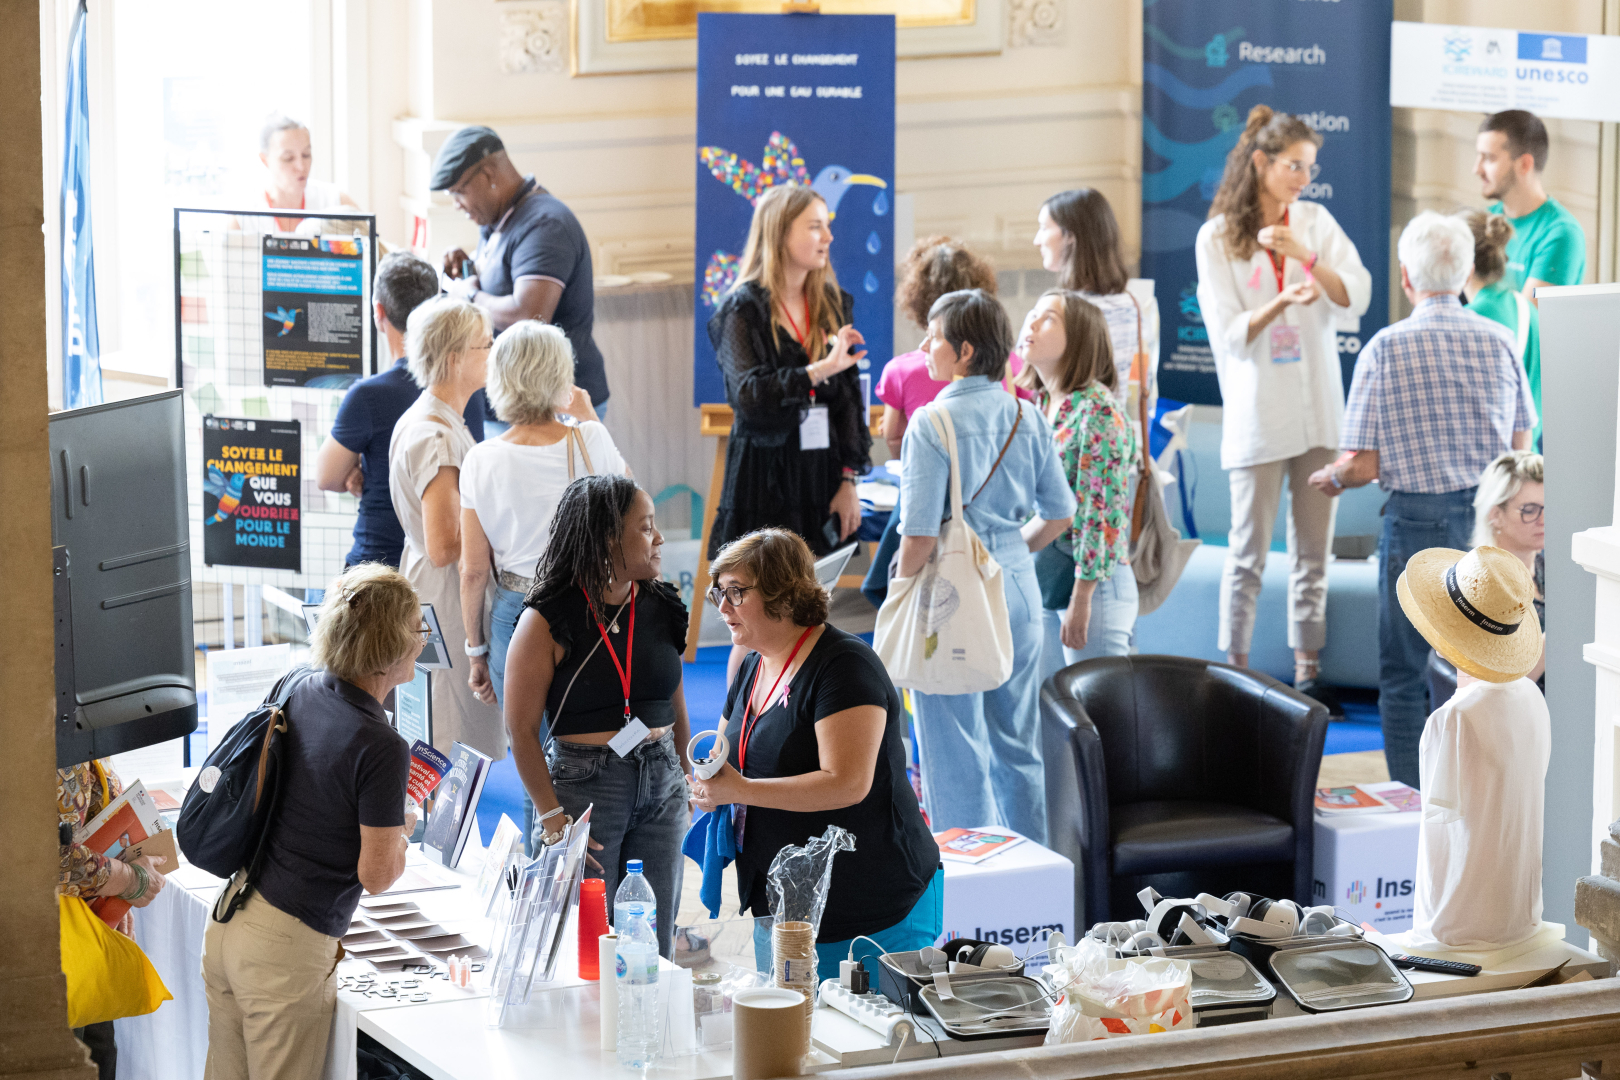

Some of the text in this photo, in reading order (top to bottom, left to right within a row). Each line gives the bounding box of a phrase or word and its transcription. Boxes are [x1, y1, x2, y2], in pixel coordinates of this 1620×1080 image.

[774, 53, 788, 66] LE
[1238, 41, 1326, 65] Research
[1515, 67, 1588, 84] unesco
[221, 445, 283, 462] SOYEZ LE
[206, 458, 298, 477] CHANGEMENT
[249, 476, 277, 490] QUE
[253, 491, 292, 506] VOUS
[235, 518, 290, 534] POUR LE
[235, 533, 285, 548] MONDE
[411, 760, 430, 775] estival
[1376, 877, 1416, 899] Ins
[975, 922, 1064, 946] Inserm
